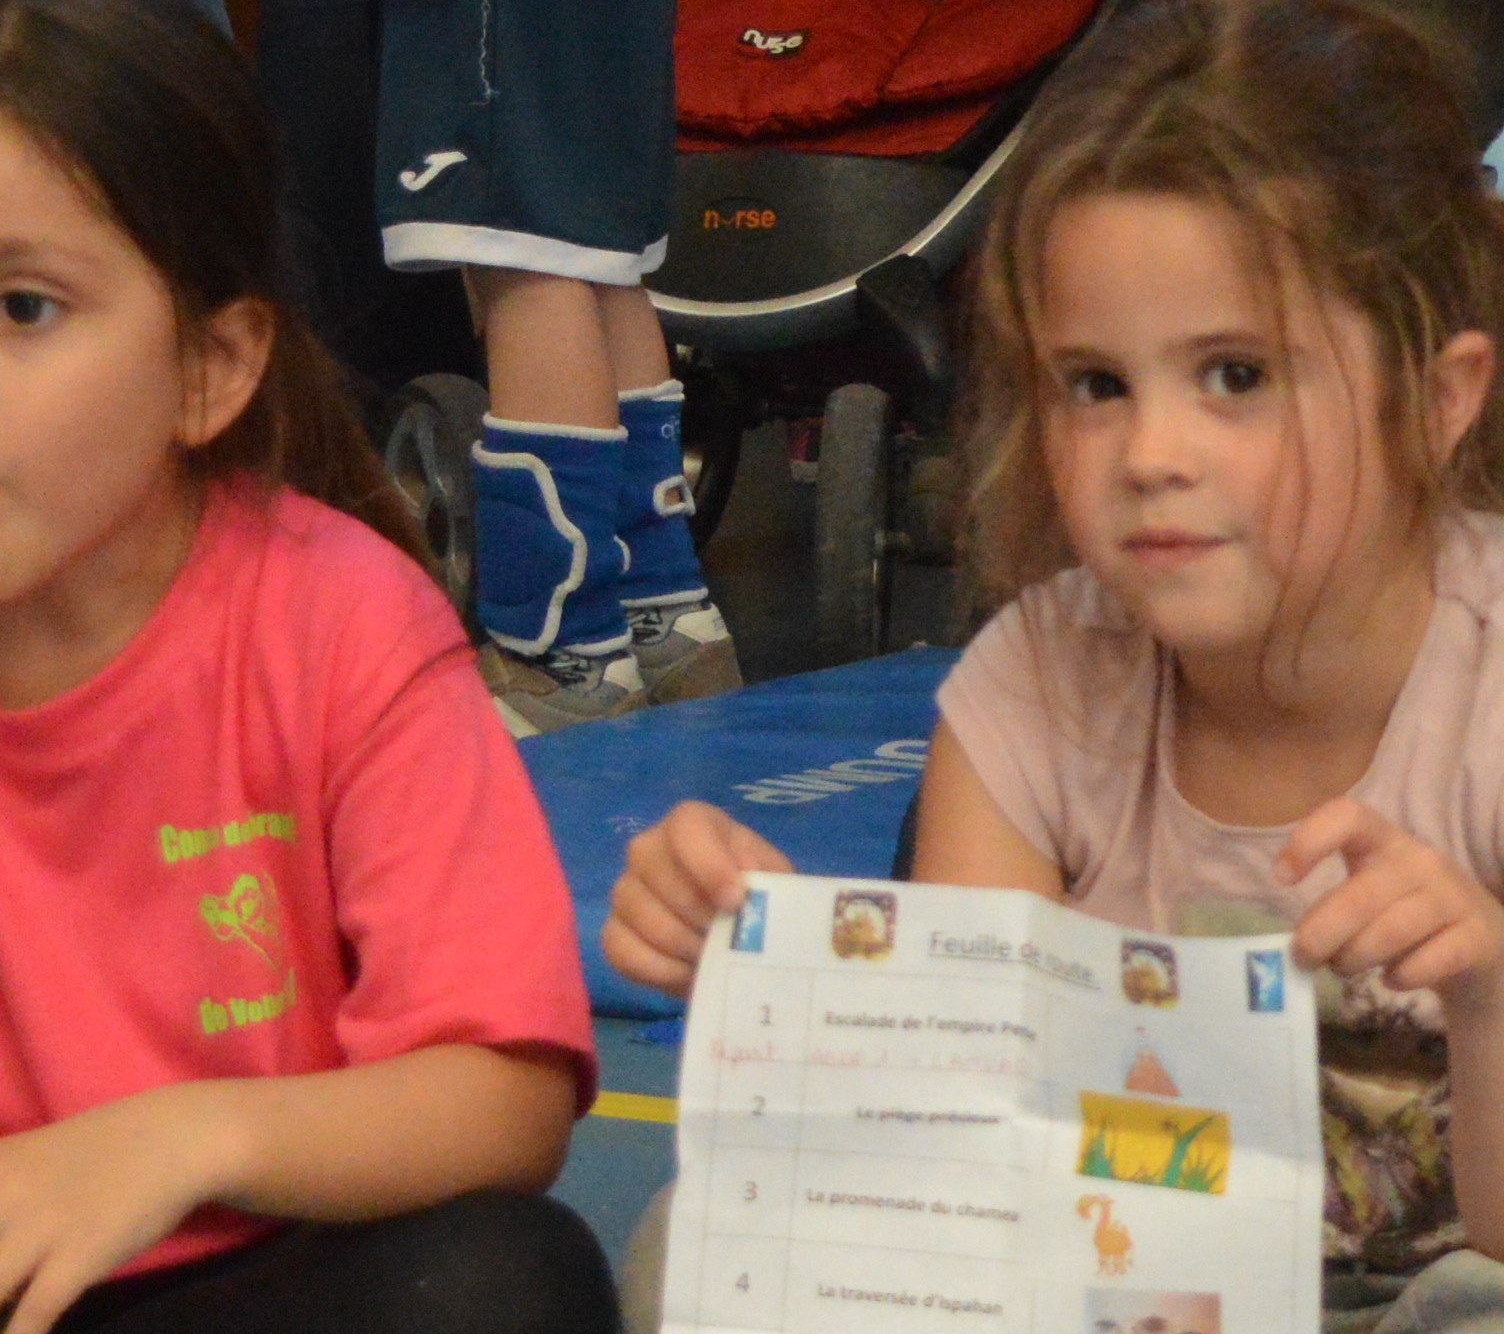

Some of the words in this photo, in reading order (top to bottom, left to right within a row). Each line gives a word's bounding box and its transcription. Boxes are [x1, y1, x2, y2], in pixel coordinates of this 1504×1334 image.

[930, 930, 1012, 957] Feuille
[760, 1004, 771, 1025] 1
[825, 1011, 896, 1028] Escalade
[902, 1013, 922, 1029] de
[752, 1095, 766, 1116] 2
[744, 1181, 758, 1202] 3
[807, 1188, 825, 1202] La
[830, 1191, 926, 1213] promenade
[931, 1200, 951, 1215] du
[736, 1271, 750, 1293] 4
[818, 1283, 835, 1298] La
[841, 1286, 918, 1307] traversée
